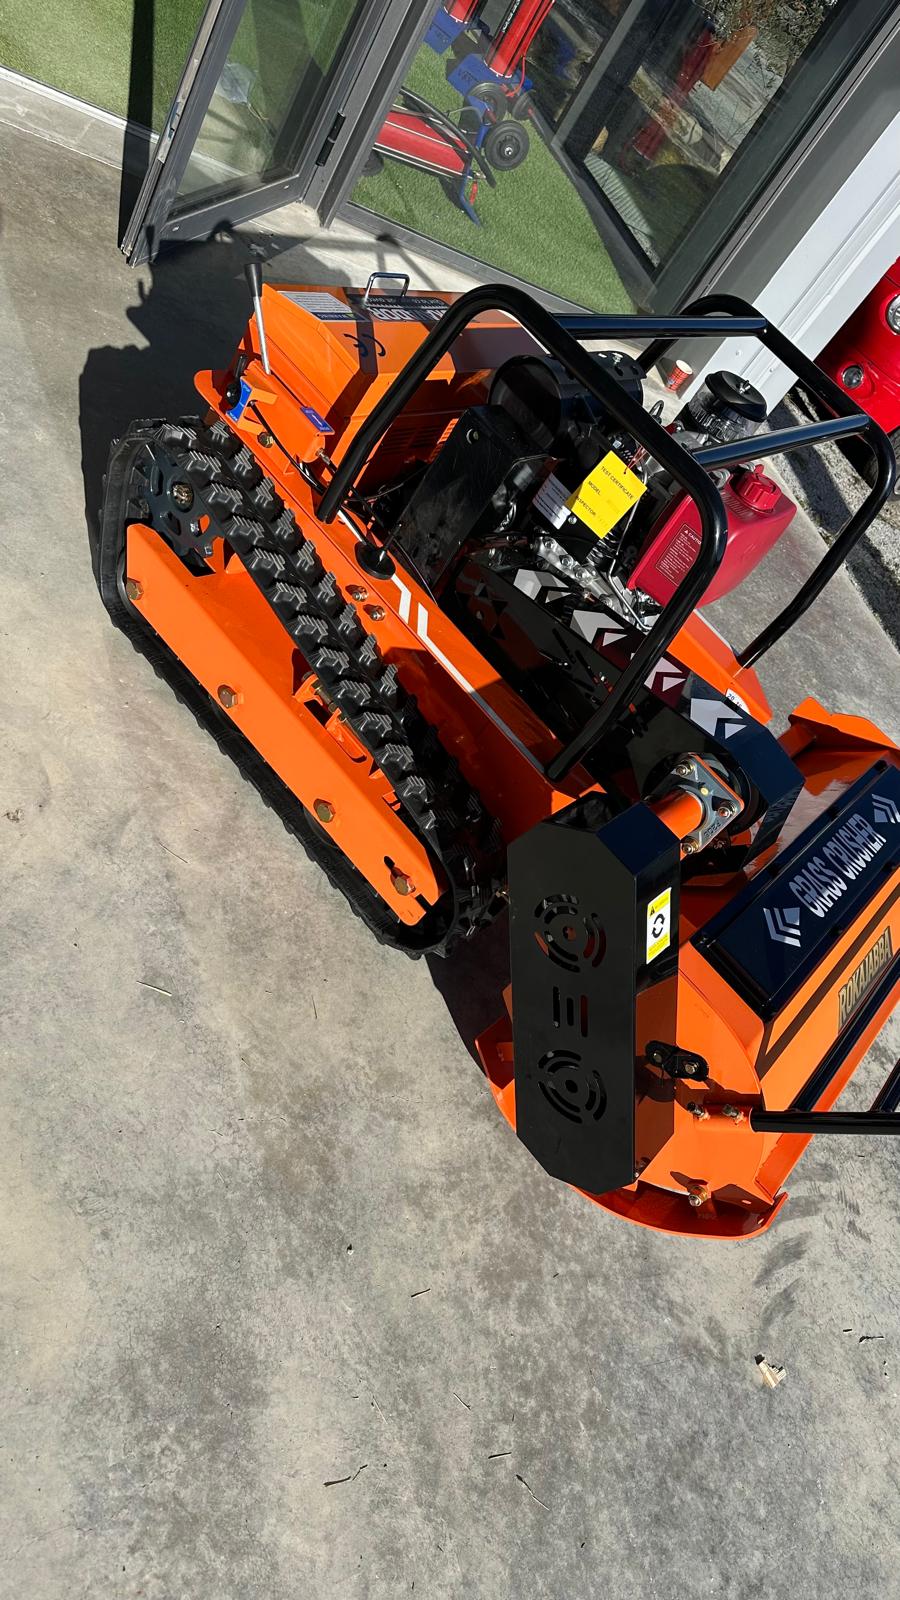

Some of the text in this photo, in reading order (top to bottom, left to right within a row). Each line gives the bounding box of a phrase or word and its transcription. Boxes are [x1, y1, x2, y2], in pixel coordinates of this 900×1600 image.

[600, 465, 612, 477] TEST
[610, 478, 635, 501] CERTIFICATE
[788, 813, 887, 918] GRASS CRUSHER
[839, 926, 892, 1023] ROKAJABBA
